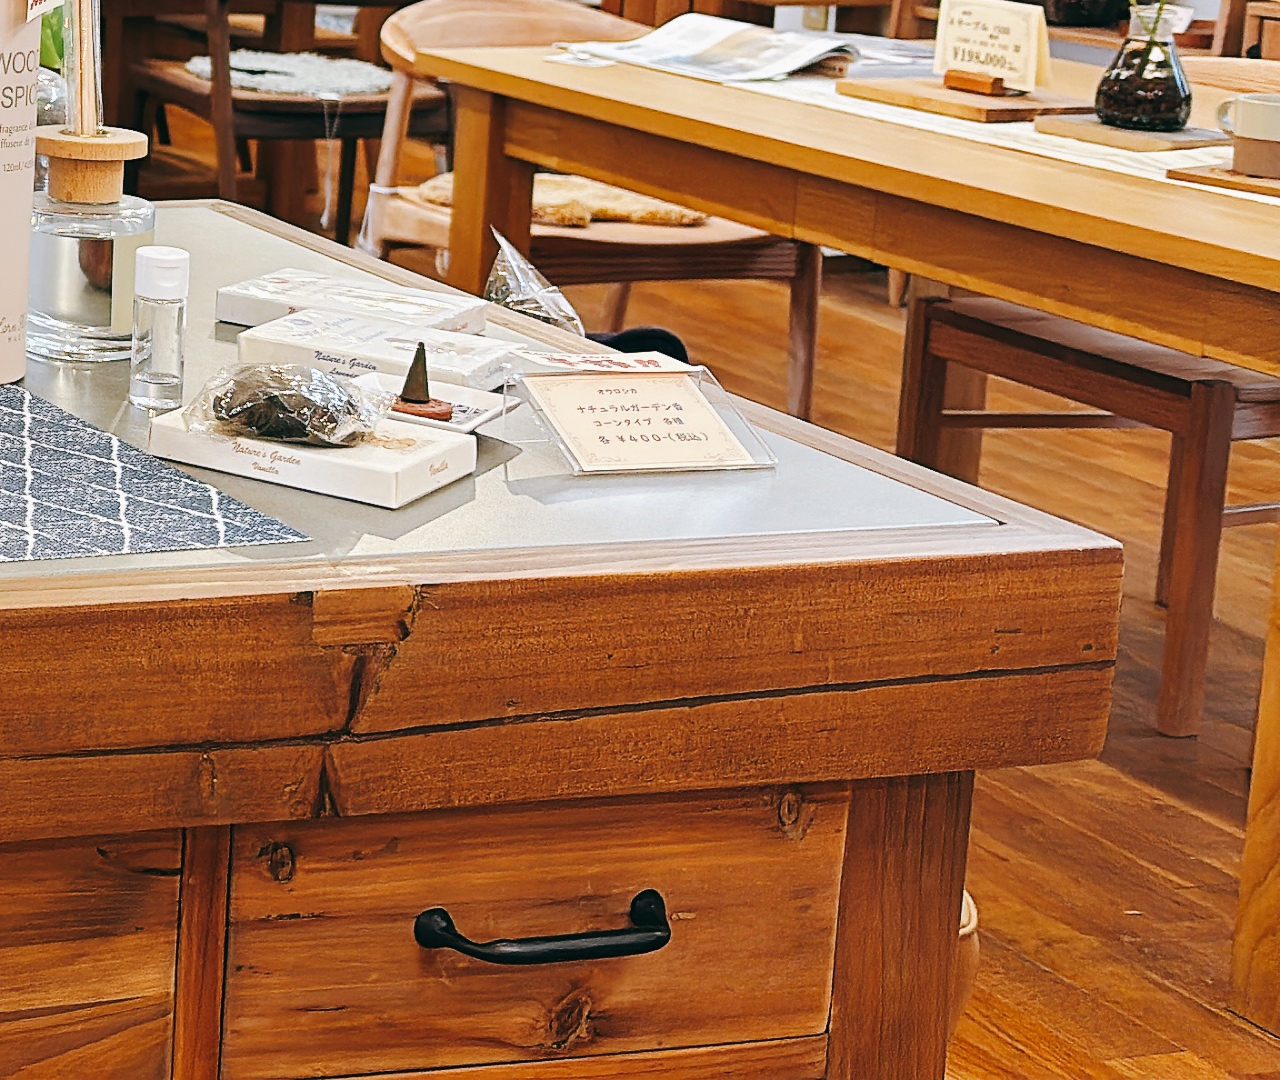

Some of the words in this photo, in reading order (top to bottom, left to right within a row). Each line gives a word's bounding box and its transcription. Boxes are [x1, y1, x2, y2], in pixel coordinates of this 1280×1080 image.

[349, 358, 377, 370] Garden
[231, 441, 267, 458] Nature's
[269, 450, 301, 466] Garden
